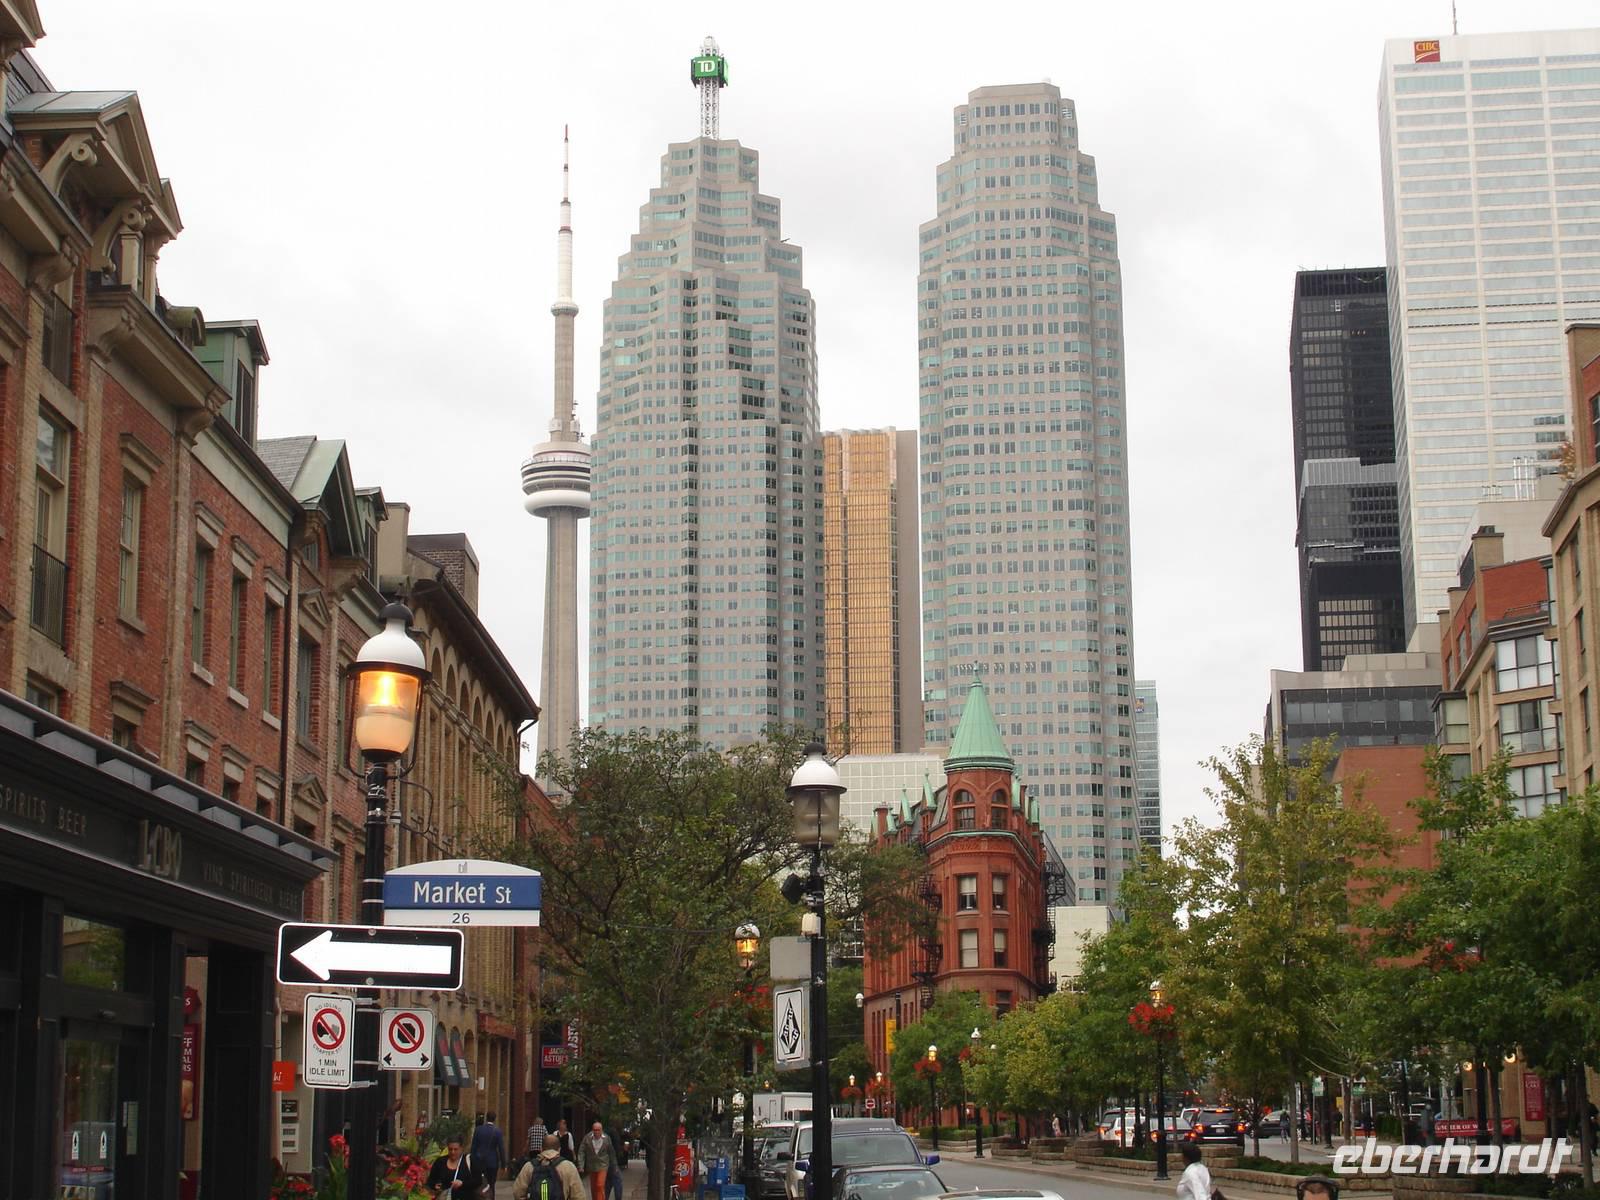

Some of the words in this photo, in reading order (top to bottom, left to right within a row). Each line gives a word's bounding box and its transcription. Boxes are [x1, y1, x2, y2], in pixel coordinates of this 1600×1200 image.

[698, 61, 715, 72] TD
[56, 806, 87, 837] BEER
[138, 819, 182, 880] LCBO
[413, 881, 486, 904] Market
[495, 886, 512, 904] St
[452, 912, 470, 924] 26
[324, 1059, 337, 1067] MIN
[309, 1067, 326, 1076] IDLE
[327, 1069, 345, 1077] LIMIT
